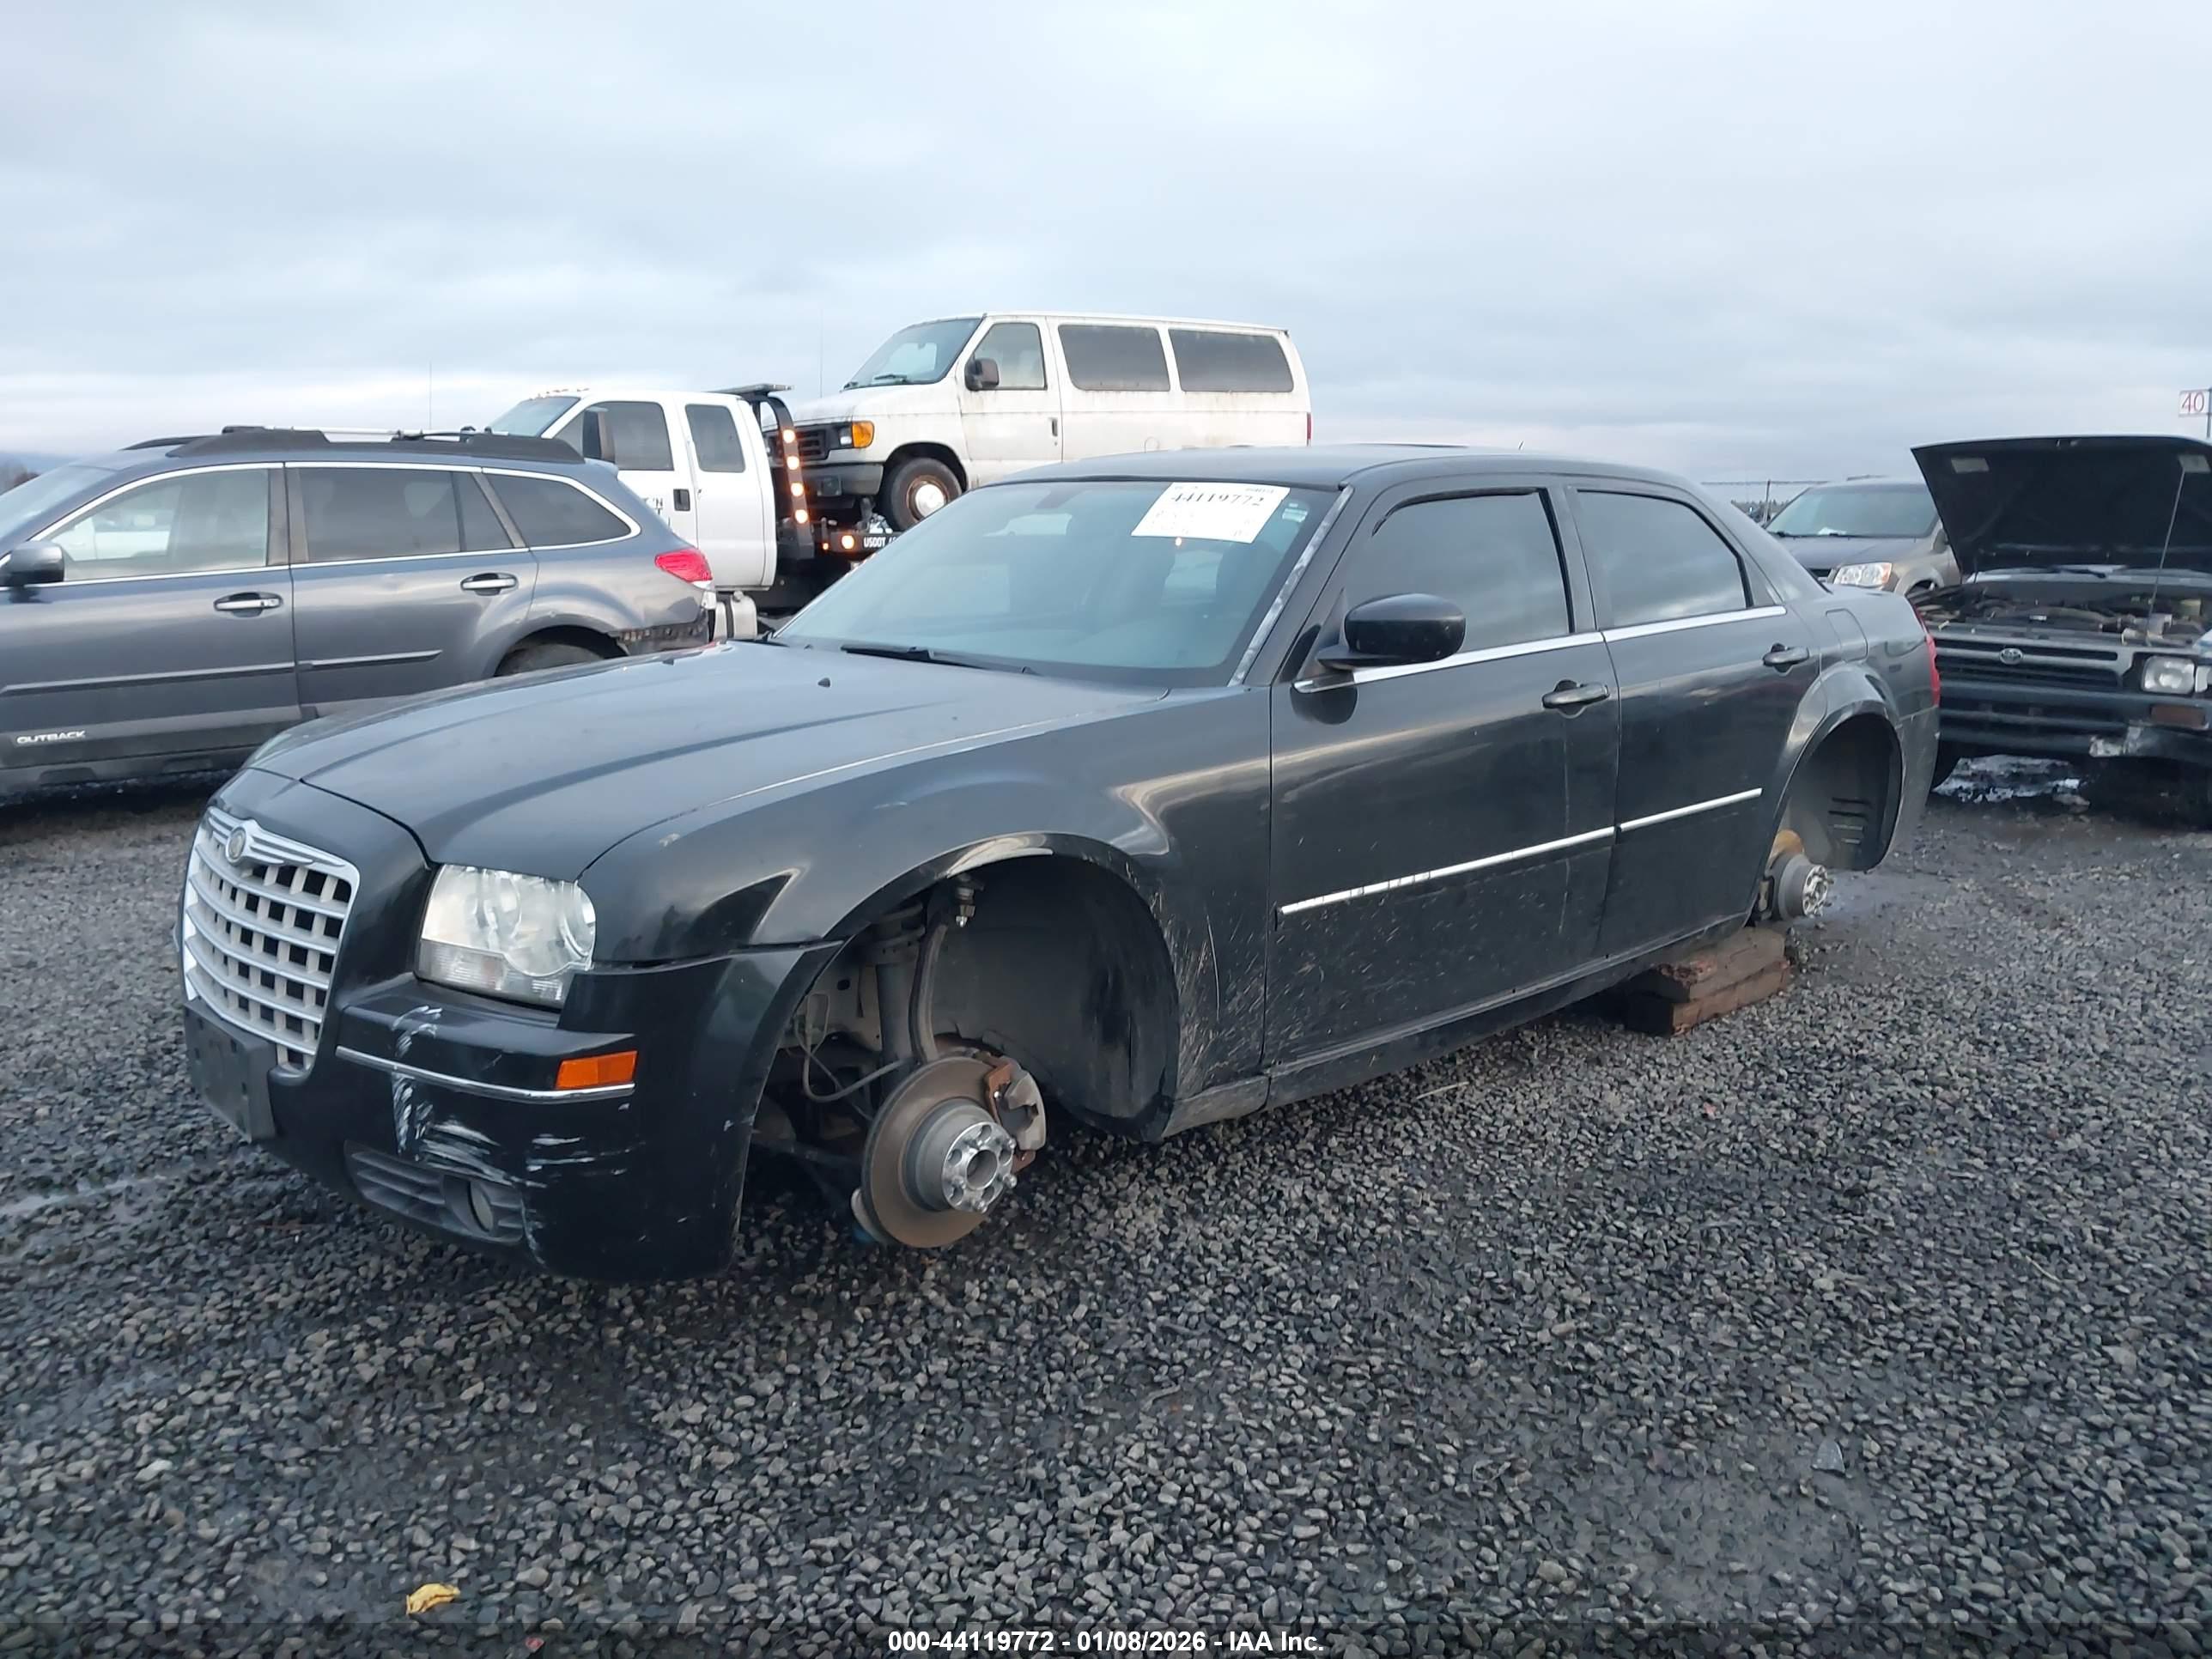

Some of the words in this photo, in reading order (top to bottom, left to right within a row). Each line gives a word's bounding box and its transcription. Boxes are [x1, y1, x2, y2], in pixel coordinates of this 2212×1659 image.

[2182, 392, 2204, 412] 40
[1170, 492, 1265, 507] 44119772
[863, 536, 886, 548] USDOT
[16, 730, 86, 744] OUTBACK
